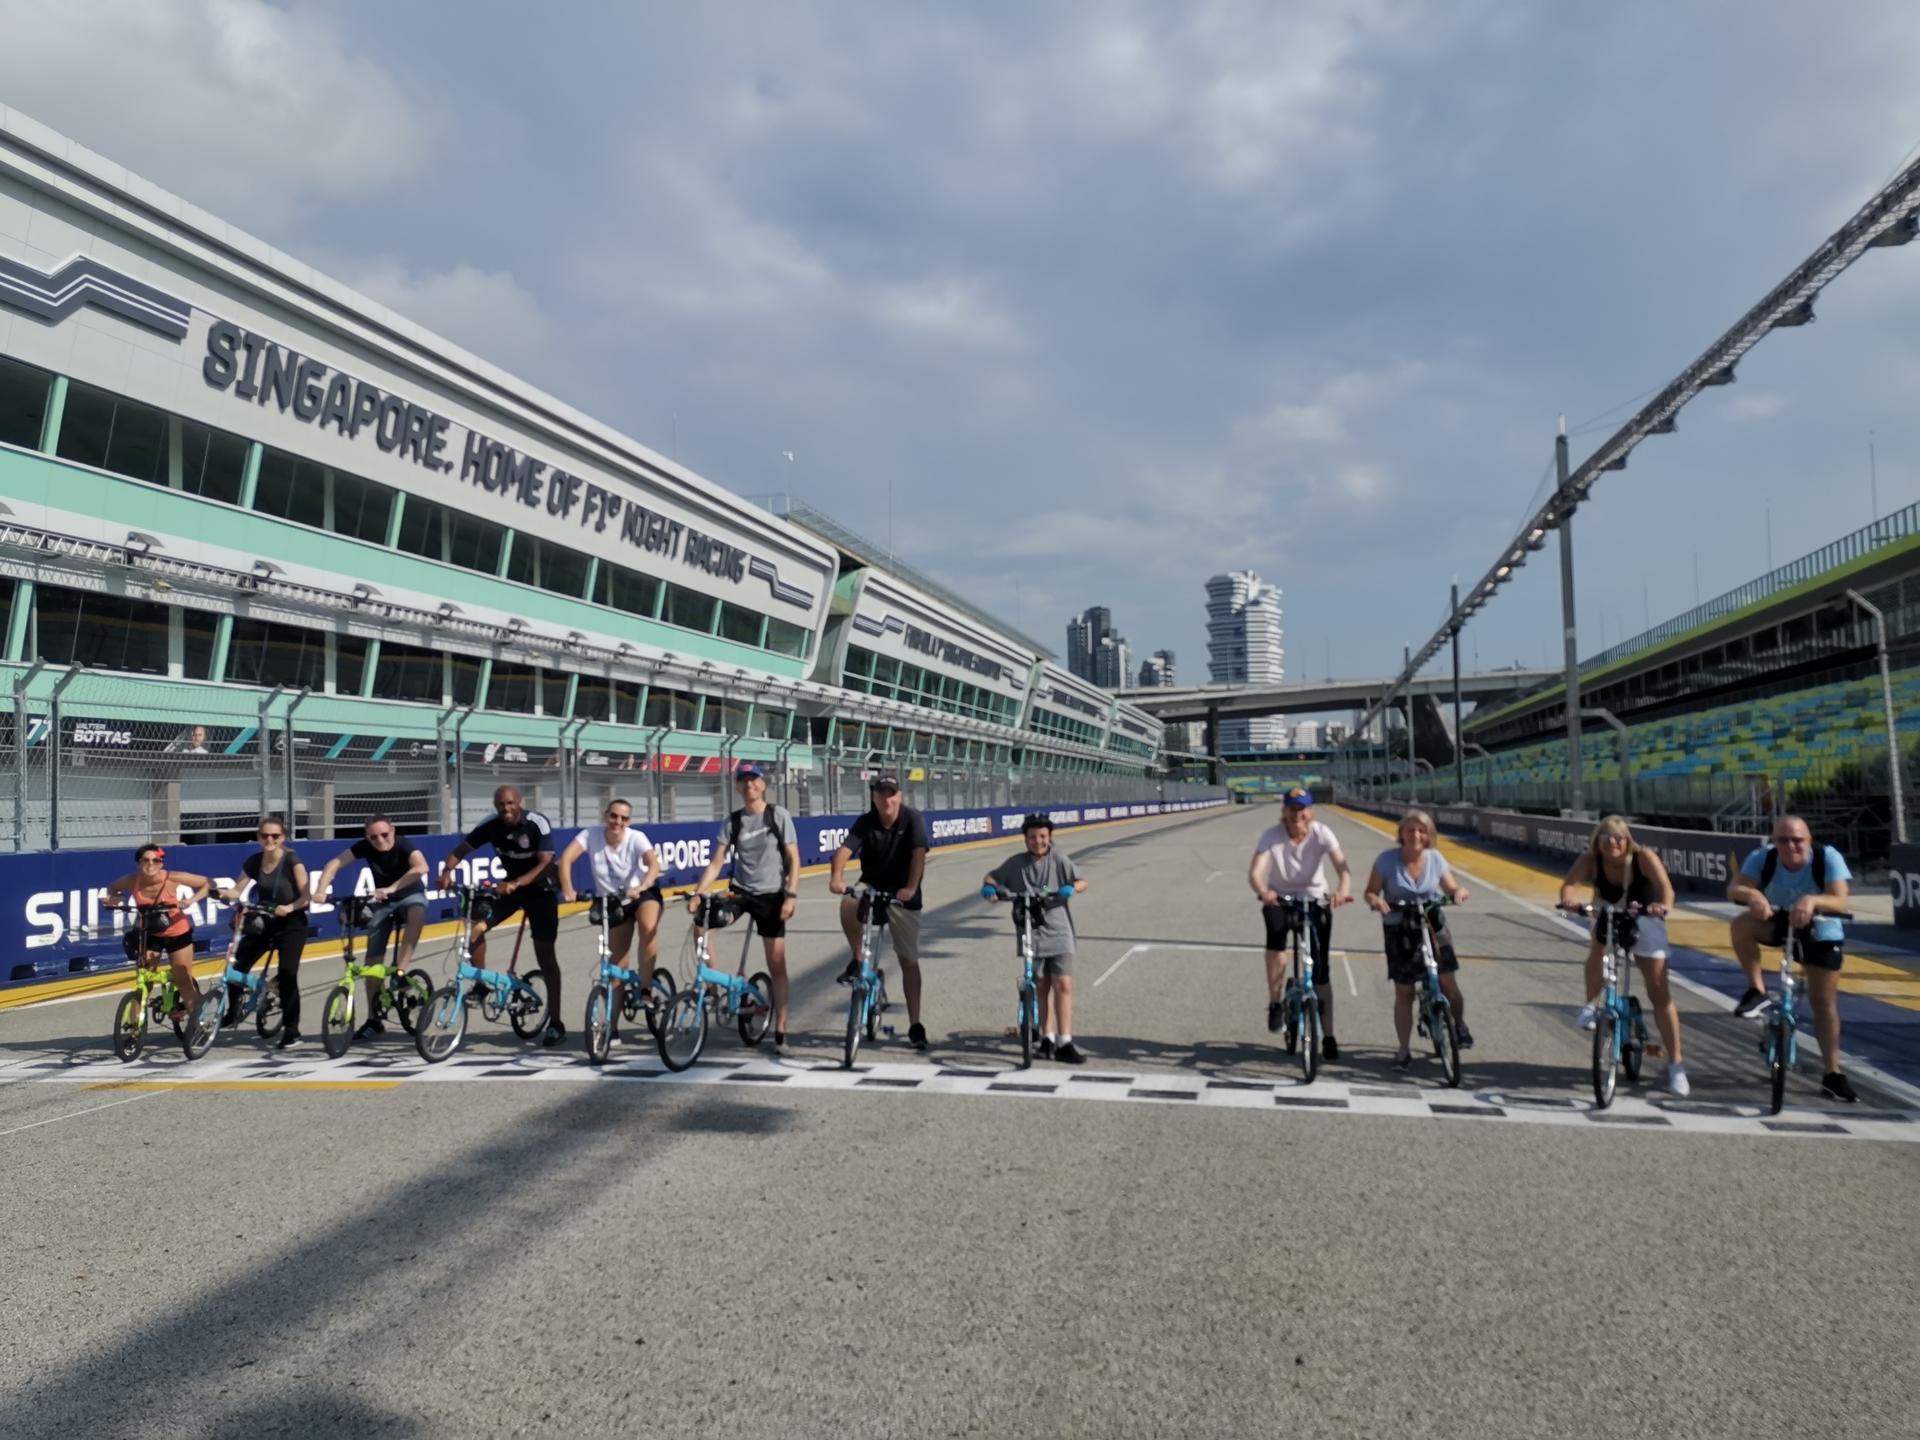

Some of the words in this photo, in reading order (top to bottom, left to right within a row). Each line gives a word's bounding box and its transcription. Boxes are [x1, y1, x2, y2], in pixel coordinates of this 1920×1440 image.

[460, 429, 547, 509] HOME
[546, 468, 583, 519] OF
[620, 500, 685, 560] NIGHT
[682, 527, 745, 585] RACING
[27, 719, 52, 740] 77
[74, 730, 131, 744] BOTTAS
